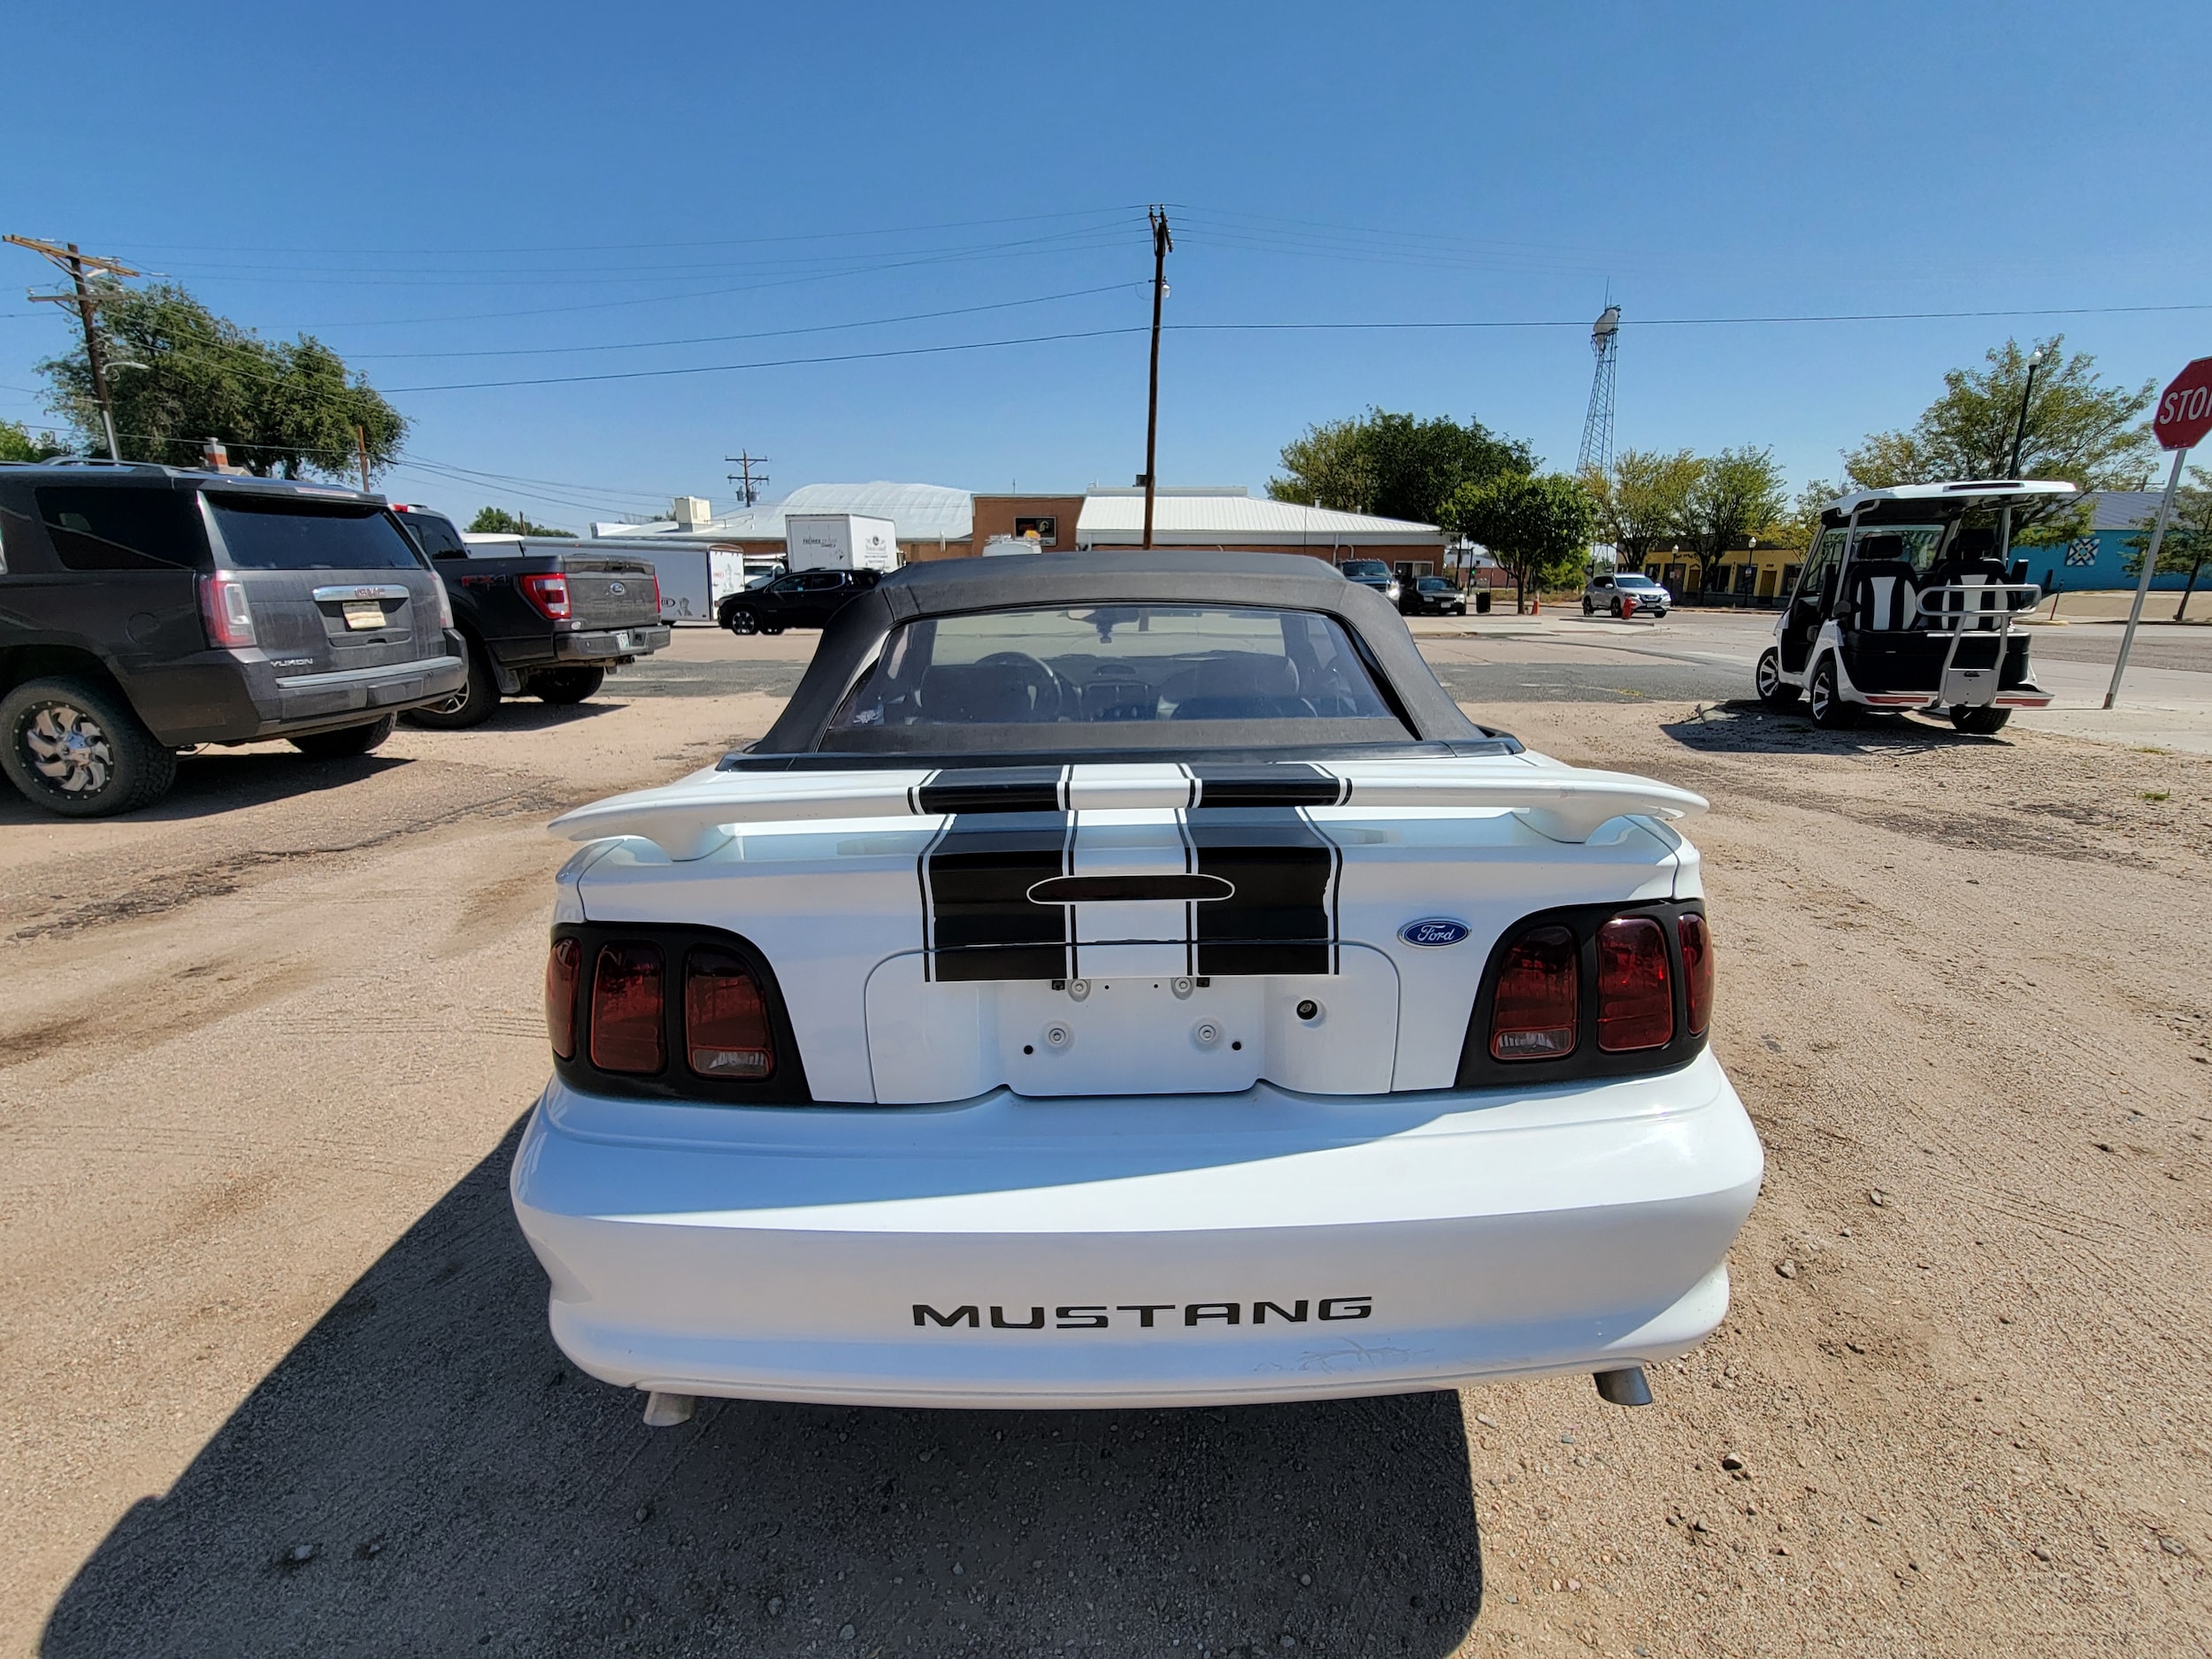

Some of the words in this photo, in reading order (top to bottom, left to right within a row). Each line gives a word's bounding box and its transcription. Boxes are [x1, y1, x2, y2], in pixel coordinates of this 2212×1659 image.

[354, 587, 385, 598] GMC
[270, 657, 313, 667] YUKON
[1417, 924, 1455, 941] Ford
[912, 1296, 1372, 1329] MUSTANG
